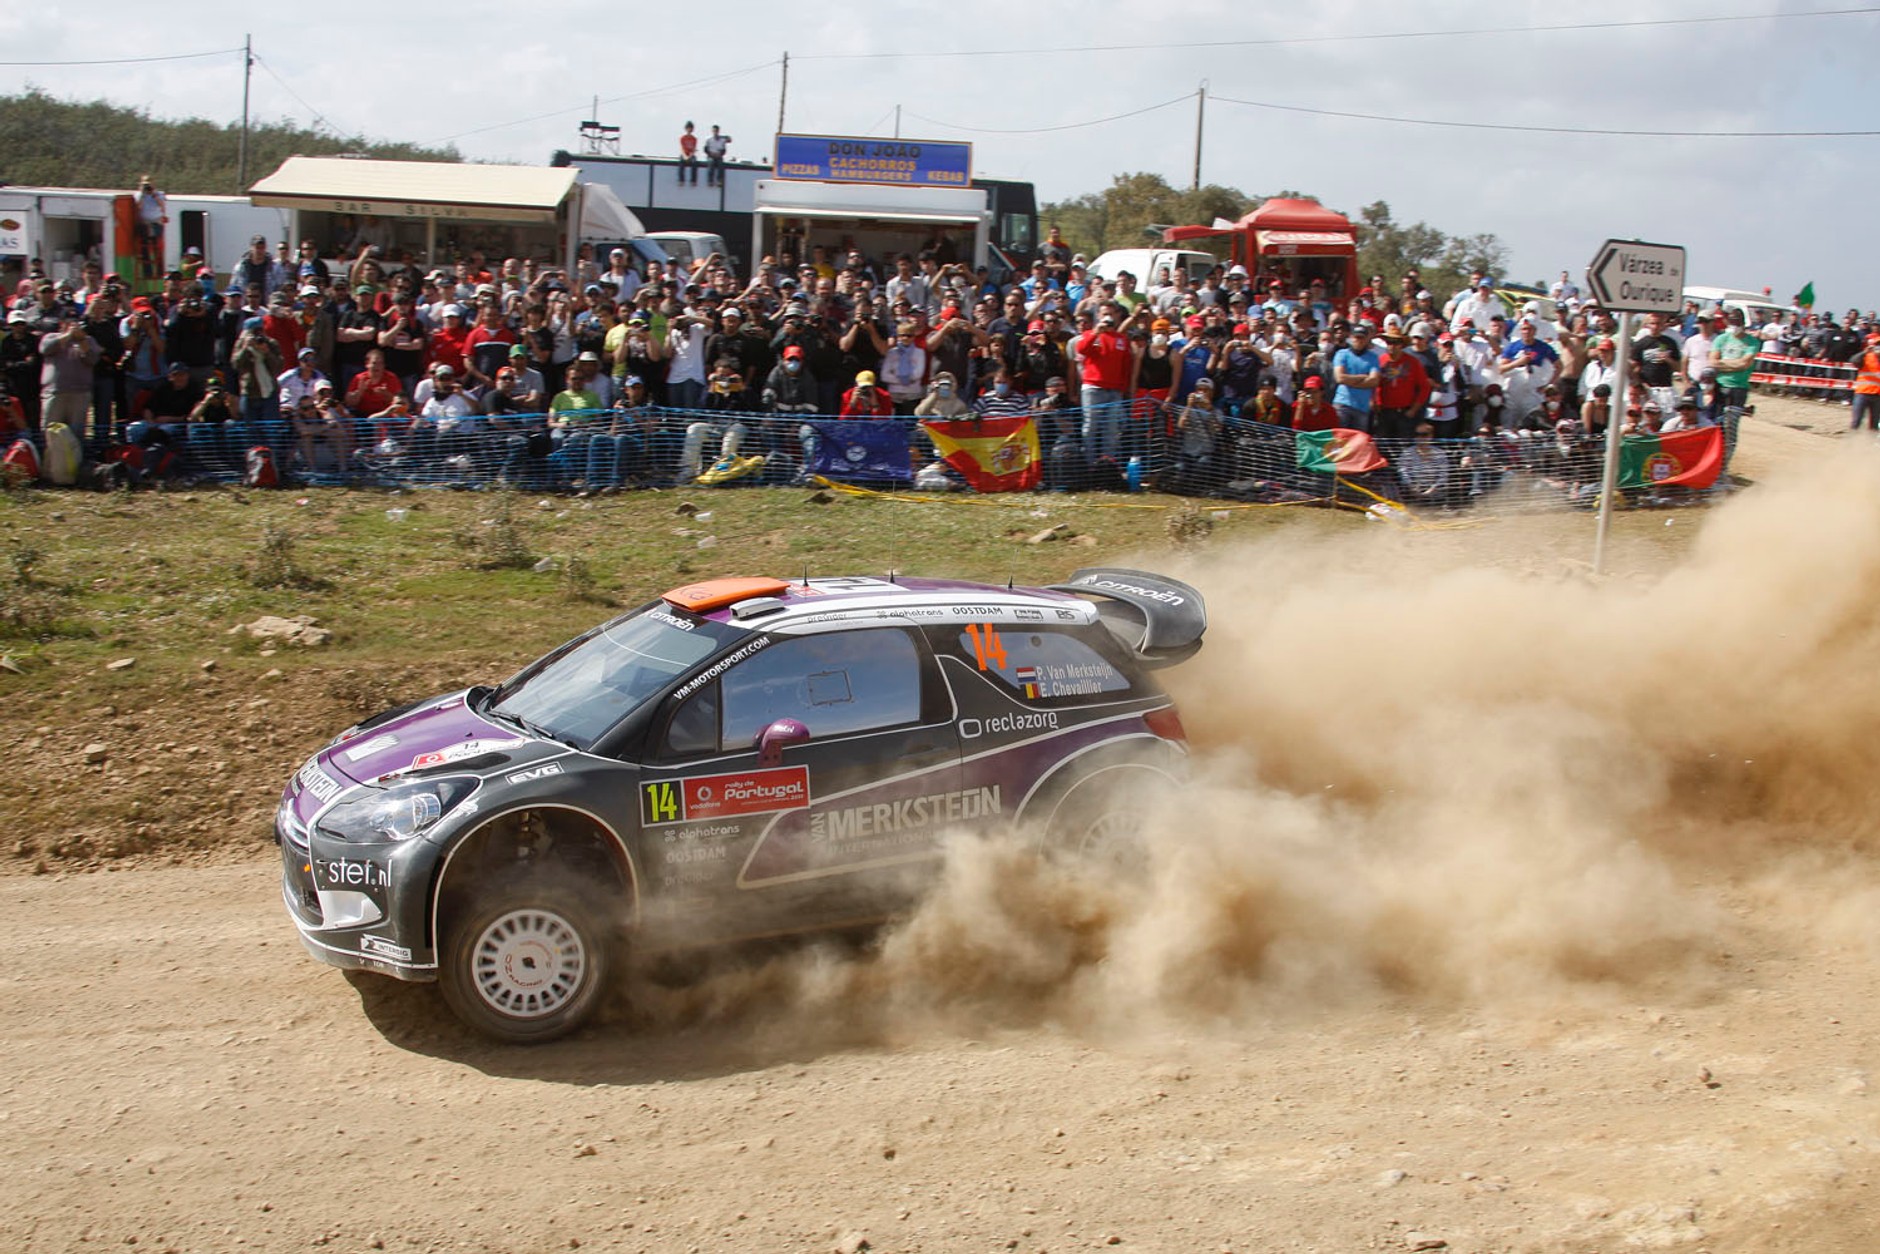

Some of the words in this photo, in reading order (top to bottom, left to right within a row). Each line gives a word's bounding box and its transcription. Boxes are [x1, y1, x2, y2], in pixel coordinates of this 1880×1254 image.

[828, 142, 865, 156] DON
[872, 142, 921, 159] JOÃO
[781, 163, 820, 175] PIZZAS
[828, 157, 916, 171] CACHORROS
[831, 169, 913, 181] HAMBURGERS
[927, 170, 965, 182] KEBAB
[334, 201, 371, 213] BAR
[1620, 252, 1663, 275] Várzea
[1621, 280, 1674, 305] Ourique
[1096, 580, 1185, 606] CITROËN
[952, 606, 1003, 616] OOSTDAM
[650, 611, 695, 632] CITROËN
[965, 622, 1008, 671] 14
[673, 637, 771, 700] VM-MOTORSPORT.COM
[1036, 665, 1047, 680] P.
[1046, 665, 1065, 680] Van
[1066, 661, 1114, 680] Merksteijn
[1040, 687, 1051, 699] E.
[985, 711, 1060, 733] reclazorg
[510, 764, 560, 784] EVG
[724, 781, 804, 800] Portugal
[647, 782, 678, 822] 14
[690, 801, 721, 810] vodafone
[828, 785, 1001, 842] MERKSTEIJN
[679, 825, 740, 840] alphatrans
[811, 812, 826, 844] VAN
[666, 847, 726, 864] OOSTDAM
